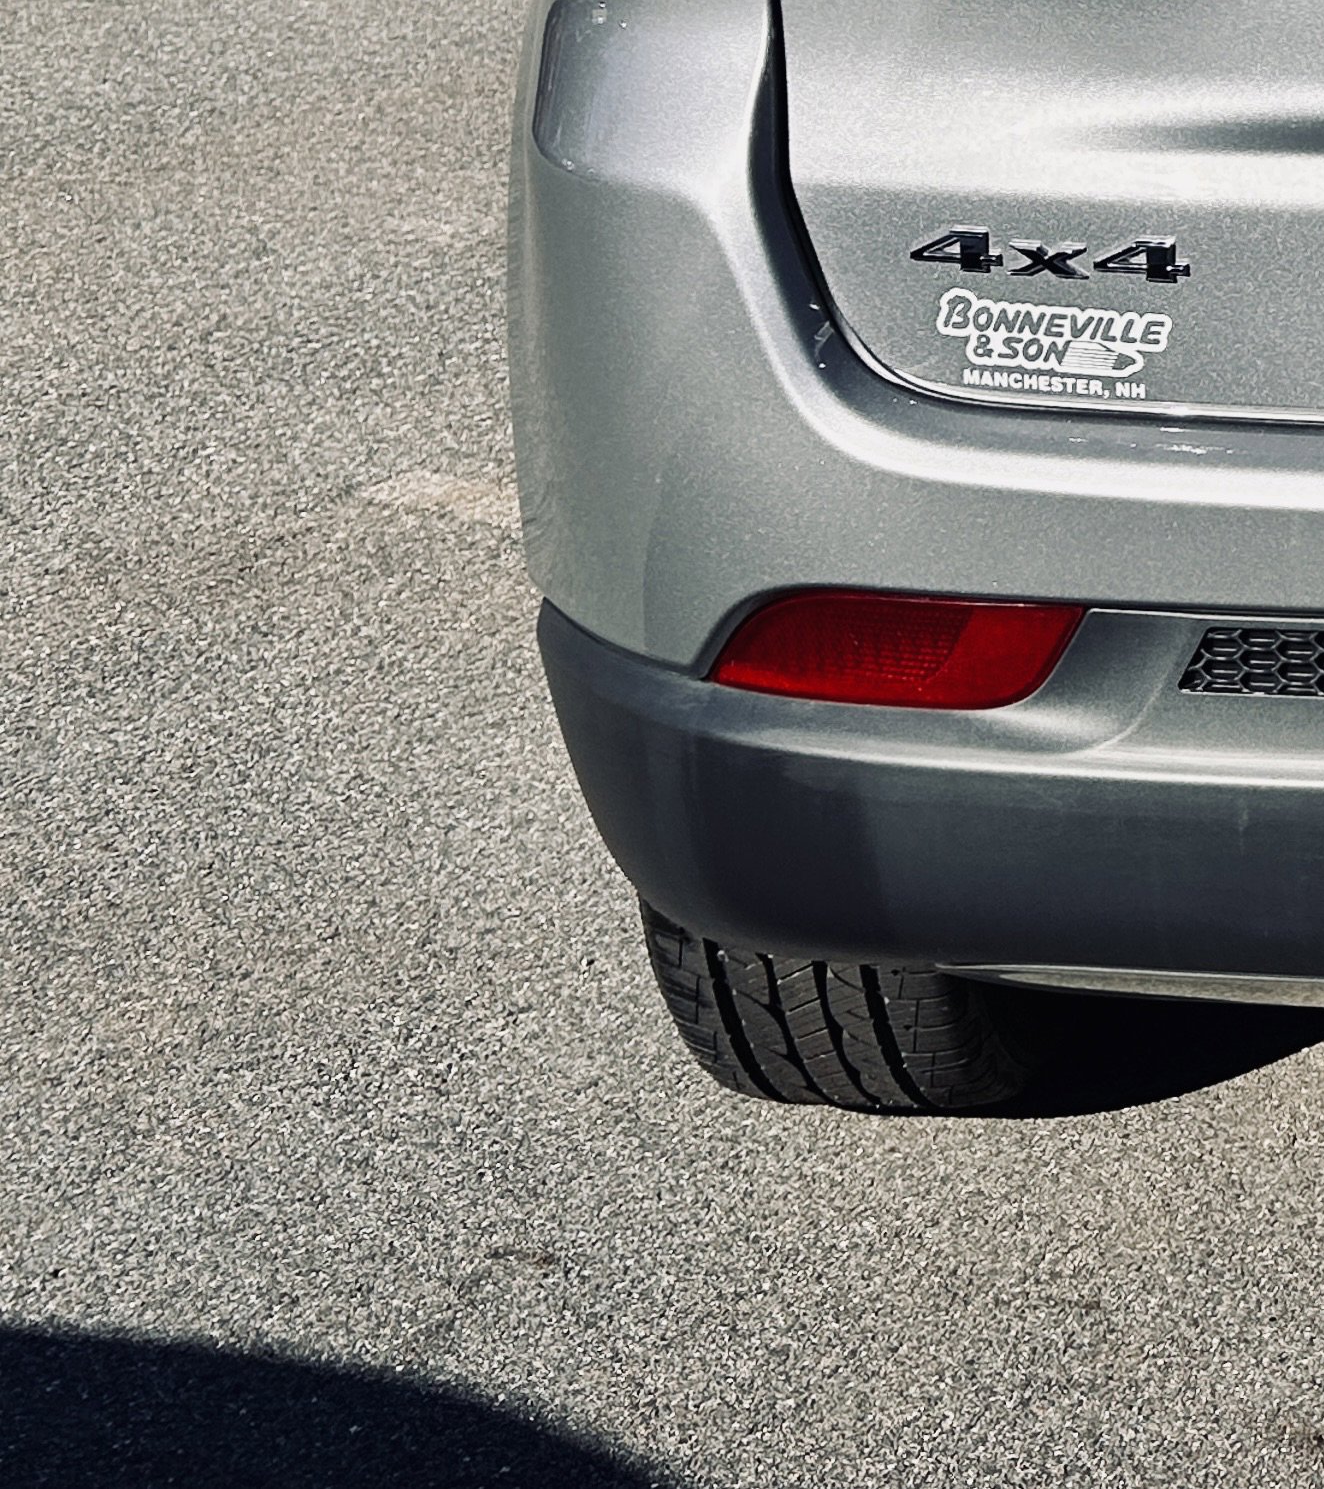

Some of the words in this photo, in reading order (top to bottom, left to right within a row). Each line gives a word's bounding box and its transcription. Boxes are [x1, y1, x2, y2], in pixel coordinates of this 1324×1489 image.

[909, 224, 1191, 284] 4x4
[942, 294, 1166, 345] BONNEVILLE
[972, 333, 993, 359] &
[997, 335, 1072, 367] SON
[962, 367, 1111, 400] MANCHESTER,
[1115, 382, 1147, 400] NH
